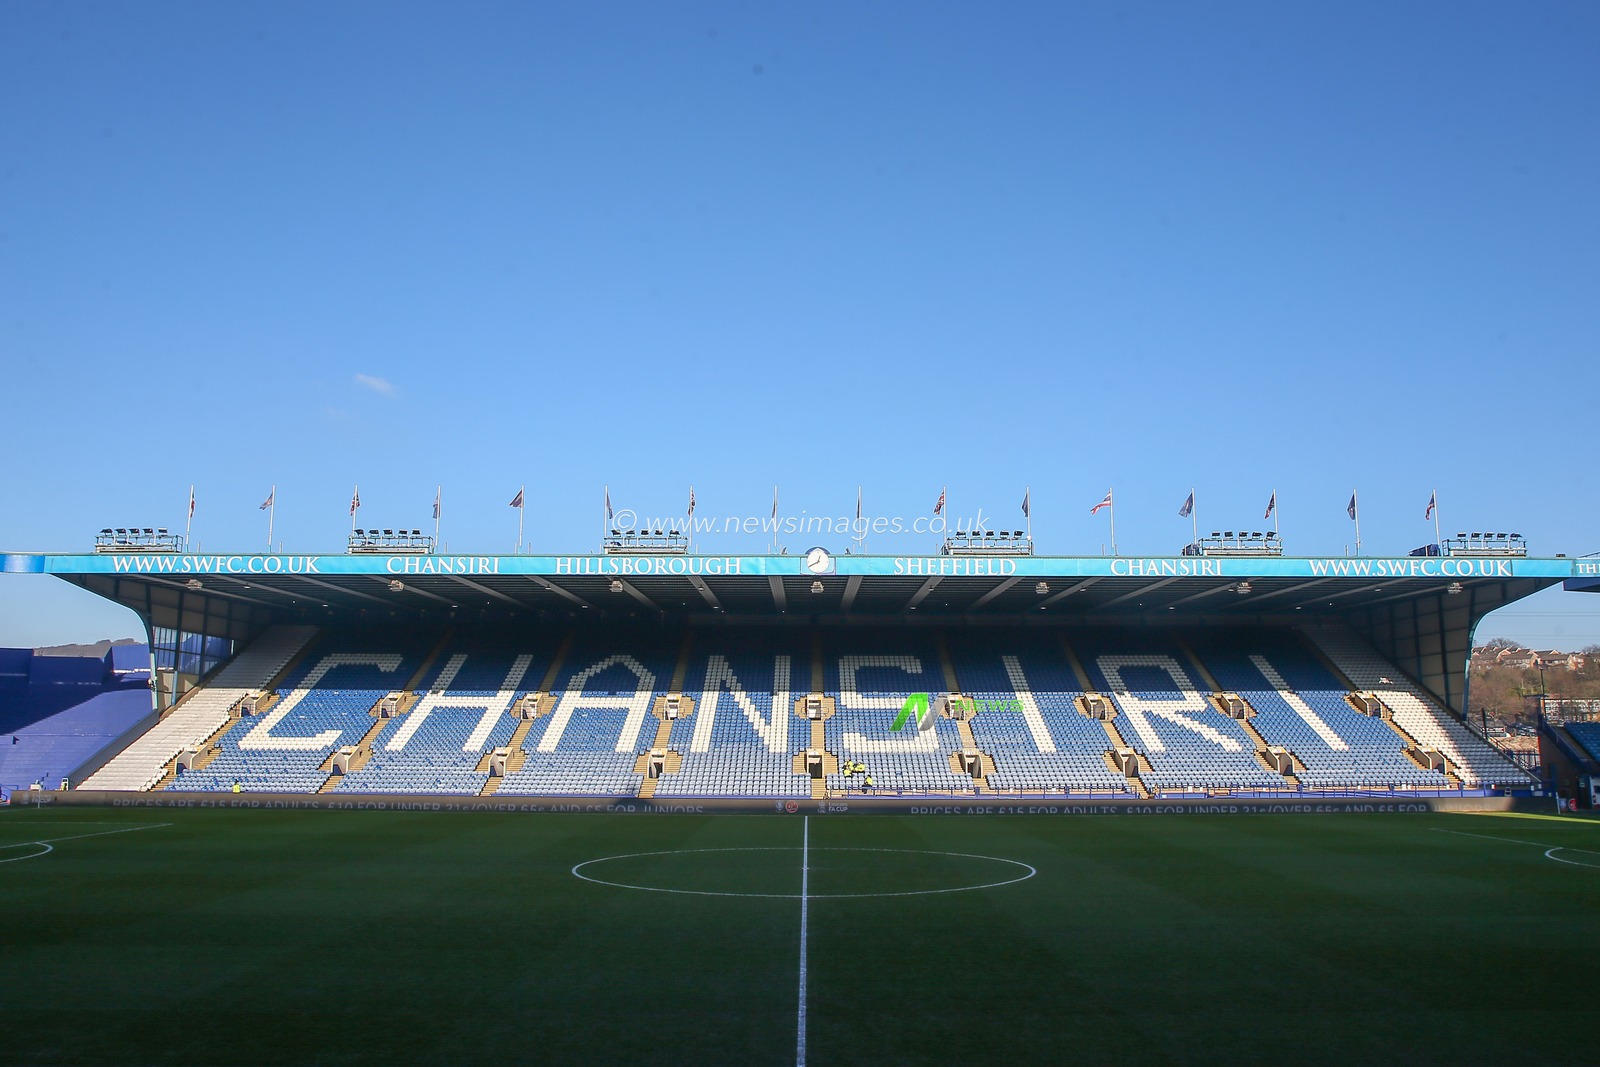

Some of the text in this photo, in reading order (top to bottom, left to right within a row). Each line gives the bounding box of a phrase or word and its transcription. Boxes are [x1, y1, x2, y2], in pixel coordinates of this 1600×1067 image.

[112, 555, 321, 575] WWW.SWFC.CO.UK
[386, 556, 500, 576] CHANSIRI
[555, 556, 742, 577] HILLSBOROUGH
[893, 557, 1017, 577] SHEFFIELD
[1110, 558, 1223, 576] CHANSIRI
[1308, 559, 1512, 577] WWW.SWFC.CO.UK
[1575, 563, 1600, 574] TH
[237, 653, 1350, 754] CHANSIRI
